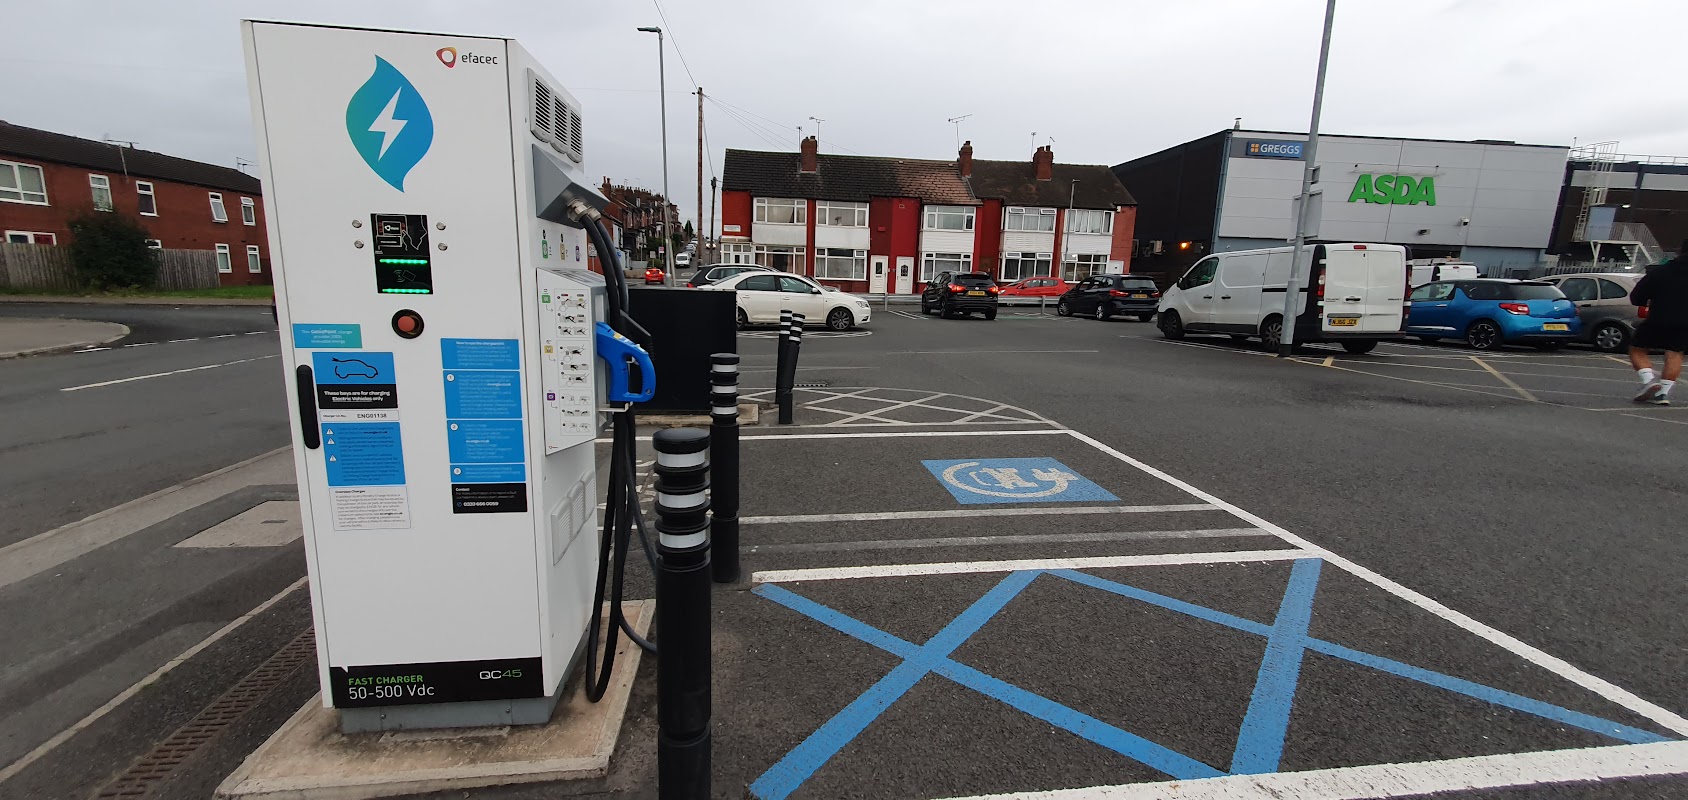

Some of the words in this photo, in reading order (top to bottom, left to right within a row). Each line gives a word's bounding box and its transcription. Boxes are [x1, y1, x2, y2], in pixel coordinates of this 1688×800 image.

[462, 52, 498, 65] efacec
[1260, 143, 1300, 155] GREGGS
[1349, 173, 1436, 206] ASDA
[349, 677, 373, 686] FAST
[375, 675, 423, 685] CHARGER
[479, 669, 523, 680] QC45
[349, 684, 403, 700] 50-500
[407, 683, 435, 697] Vdc
